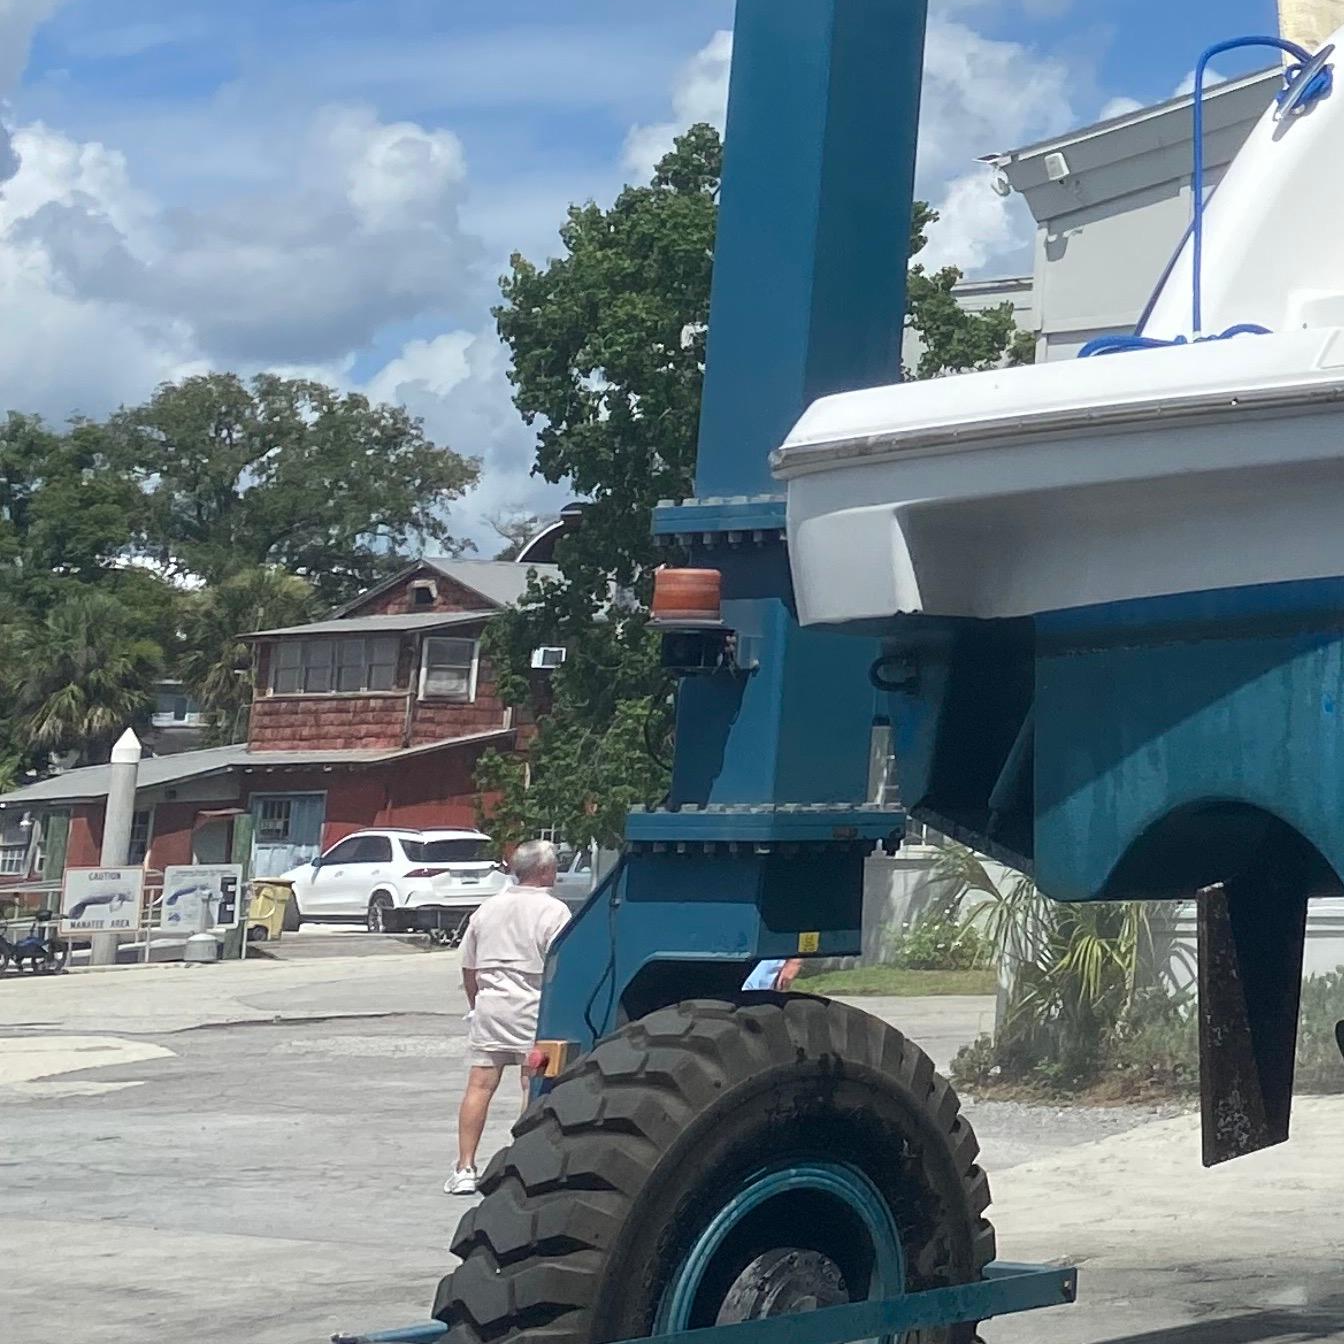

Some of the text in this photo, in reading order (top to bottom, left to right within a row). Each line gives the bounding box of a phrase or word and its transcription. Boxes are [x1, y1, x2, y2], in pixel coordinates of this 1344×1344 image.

[88, 872, 121, 881] CAUTION
[70, 919, 130, 929] MANATEE AREA
